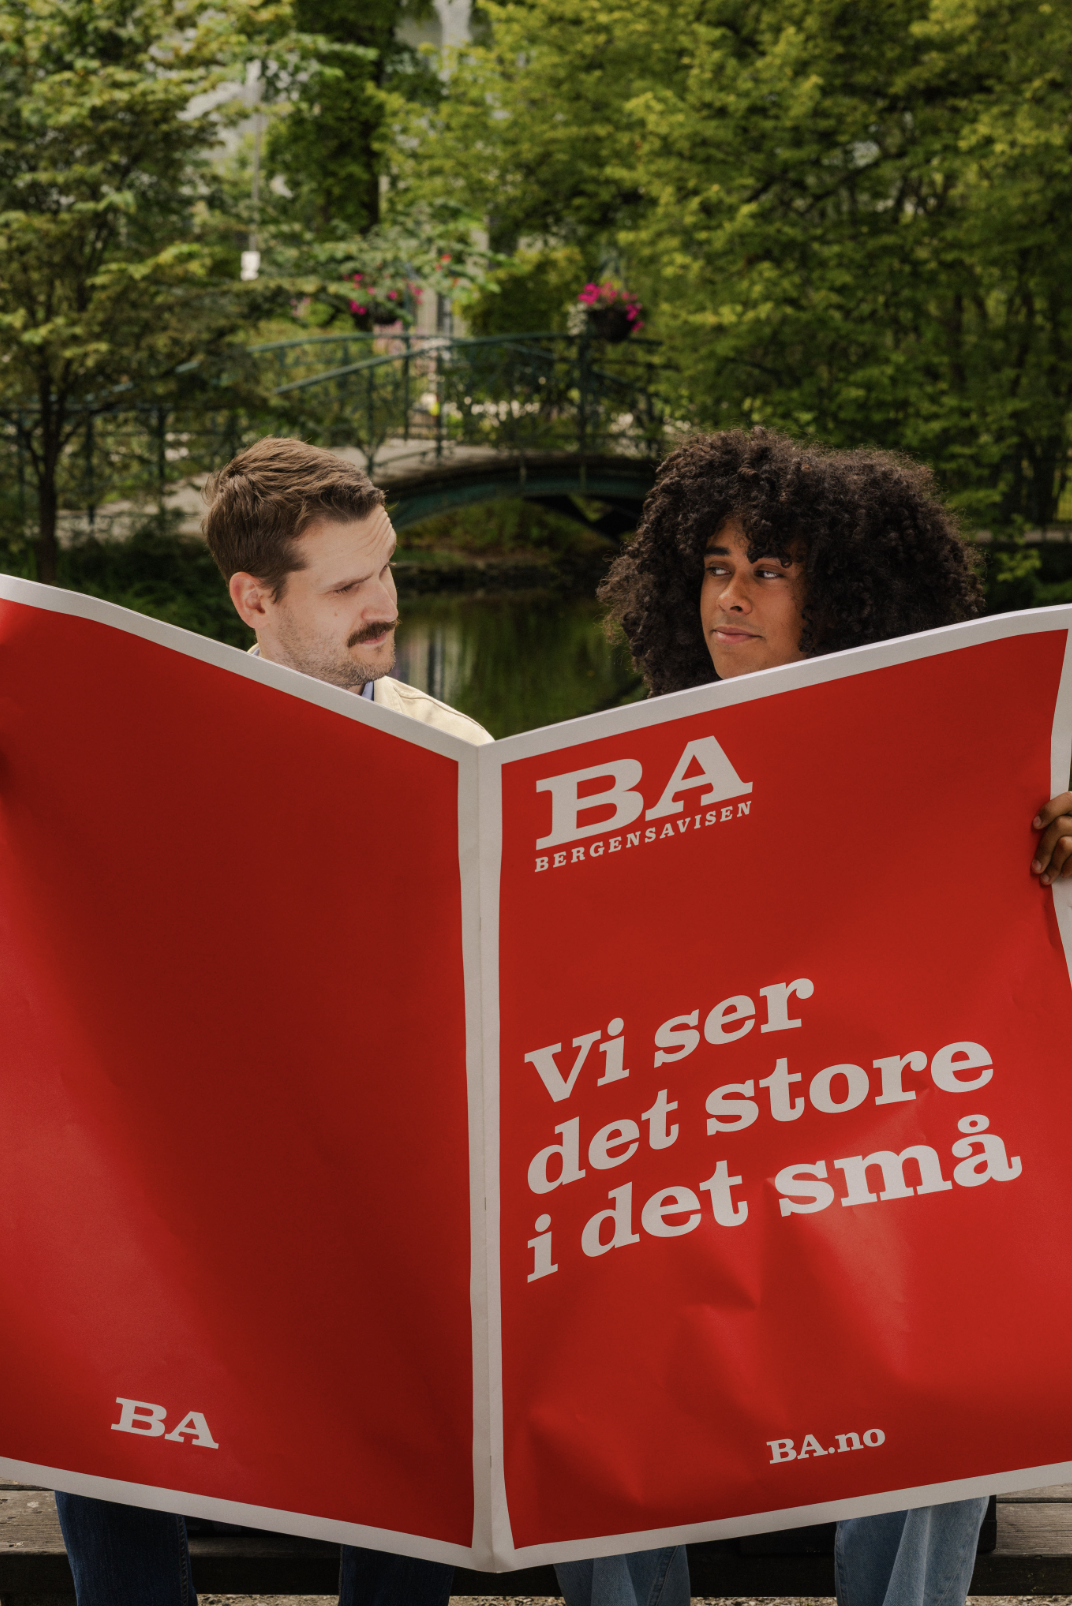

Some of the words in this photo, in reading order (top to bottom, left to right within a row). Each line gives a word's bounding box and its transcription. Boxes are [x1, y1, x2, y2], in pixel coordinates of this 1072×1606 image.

[534, 800, 752, 873] BERGENSAVISEN
[536, 735, 754, 851] BA
[524, 1017, 631, 1103] Vi
[653, 977, 815, 1068] ser
[527, 1088, 679, 1195] det
[705, 1041, 994, 1136] store
[526, 1213, 560, 1283] i
[581, 1159, 749, 1258] det
[774, 1113, 1023, 1218] små
[110, 1396, 219, 1450] BA
[766, 1428, 886, 1464] BA.no
